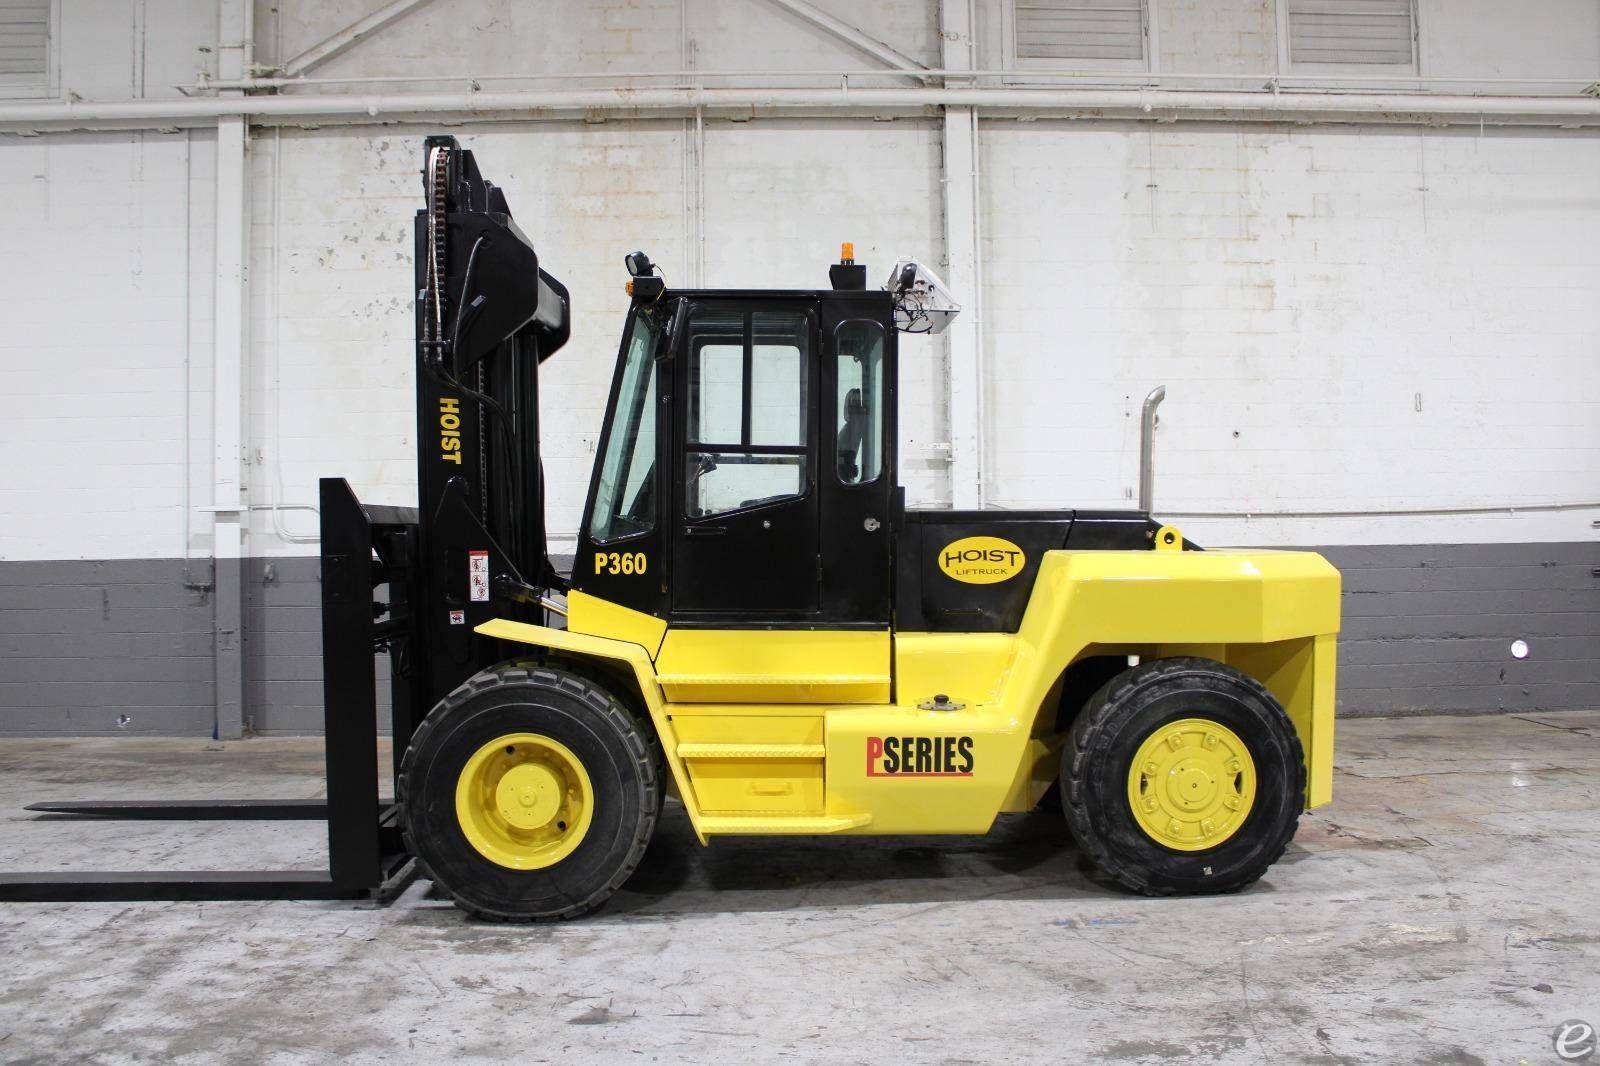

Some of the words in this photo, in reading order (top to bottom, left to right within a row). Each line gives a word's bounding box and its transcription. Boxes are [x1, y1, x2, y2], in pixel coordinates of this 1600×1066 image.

[440, 397, 462, 465] HOIST
[594, 552, 647, 575] P360
[945, 549, 1020, 568] HOIST
[955, 568, 1008, 576] LIFTRUCK
